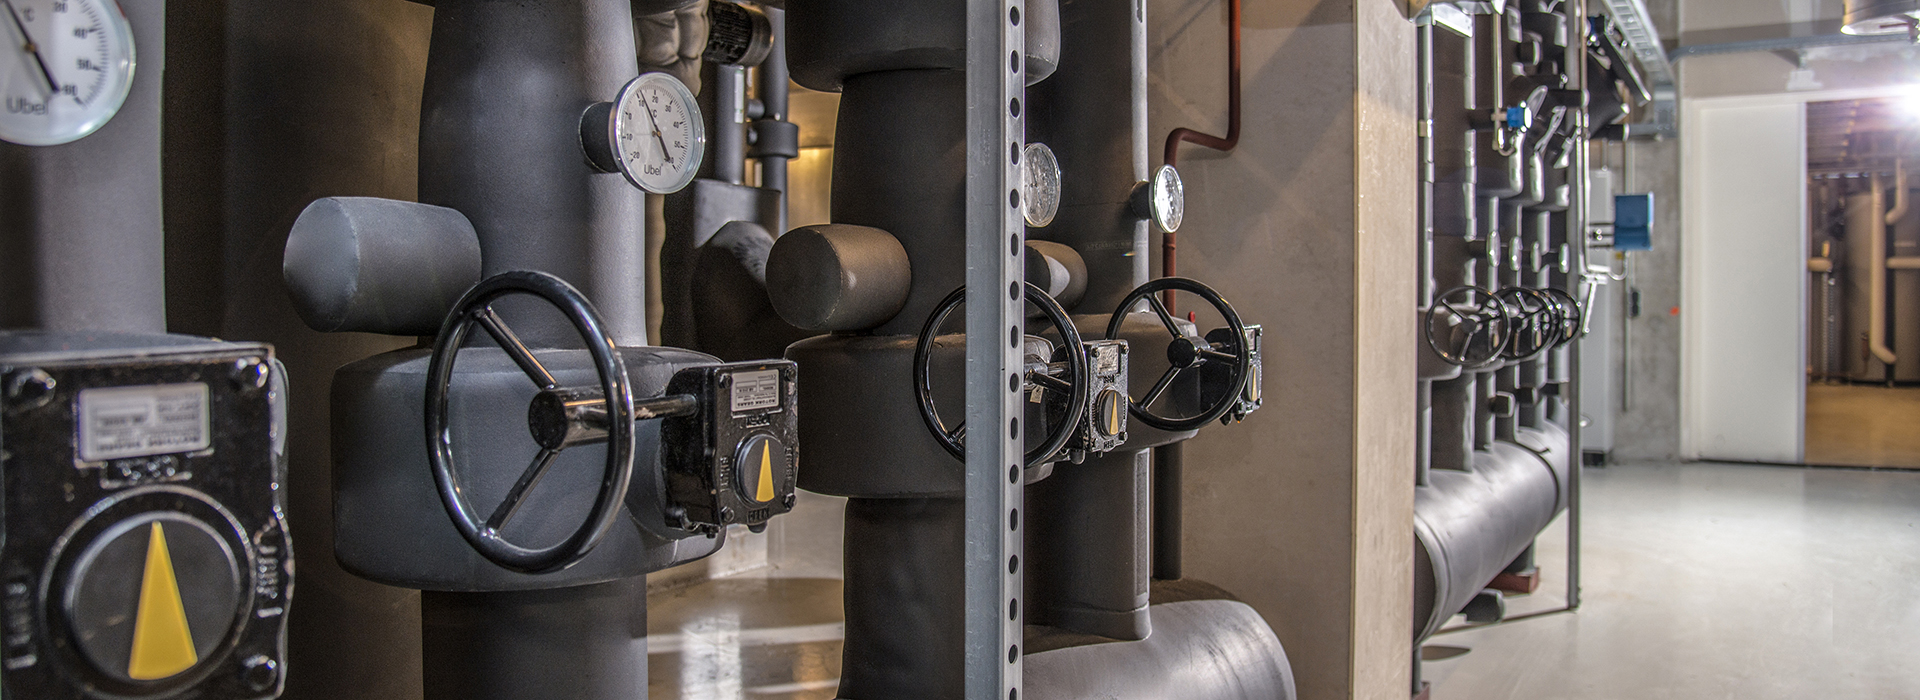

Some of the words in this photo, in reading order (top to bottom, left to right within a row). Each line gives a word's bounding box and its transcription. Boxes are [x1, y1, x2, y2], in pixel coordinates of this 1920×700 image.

[652, 95, 659, 104] 20
[7, 96, 49, 115] Ubel
[665, 104, 672, 113] 30
[673, 121, 680, 129] 40
[674, 140, 681, 148] 50
[643, 164, 662, 176] Ubel
